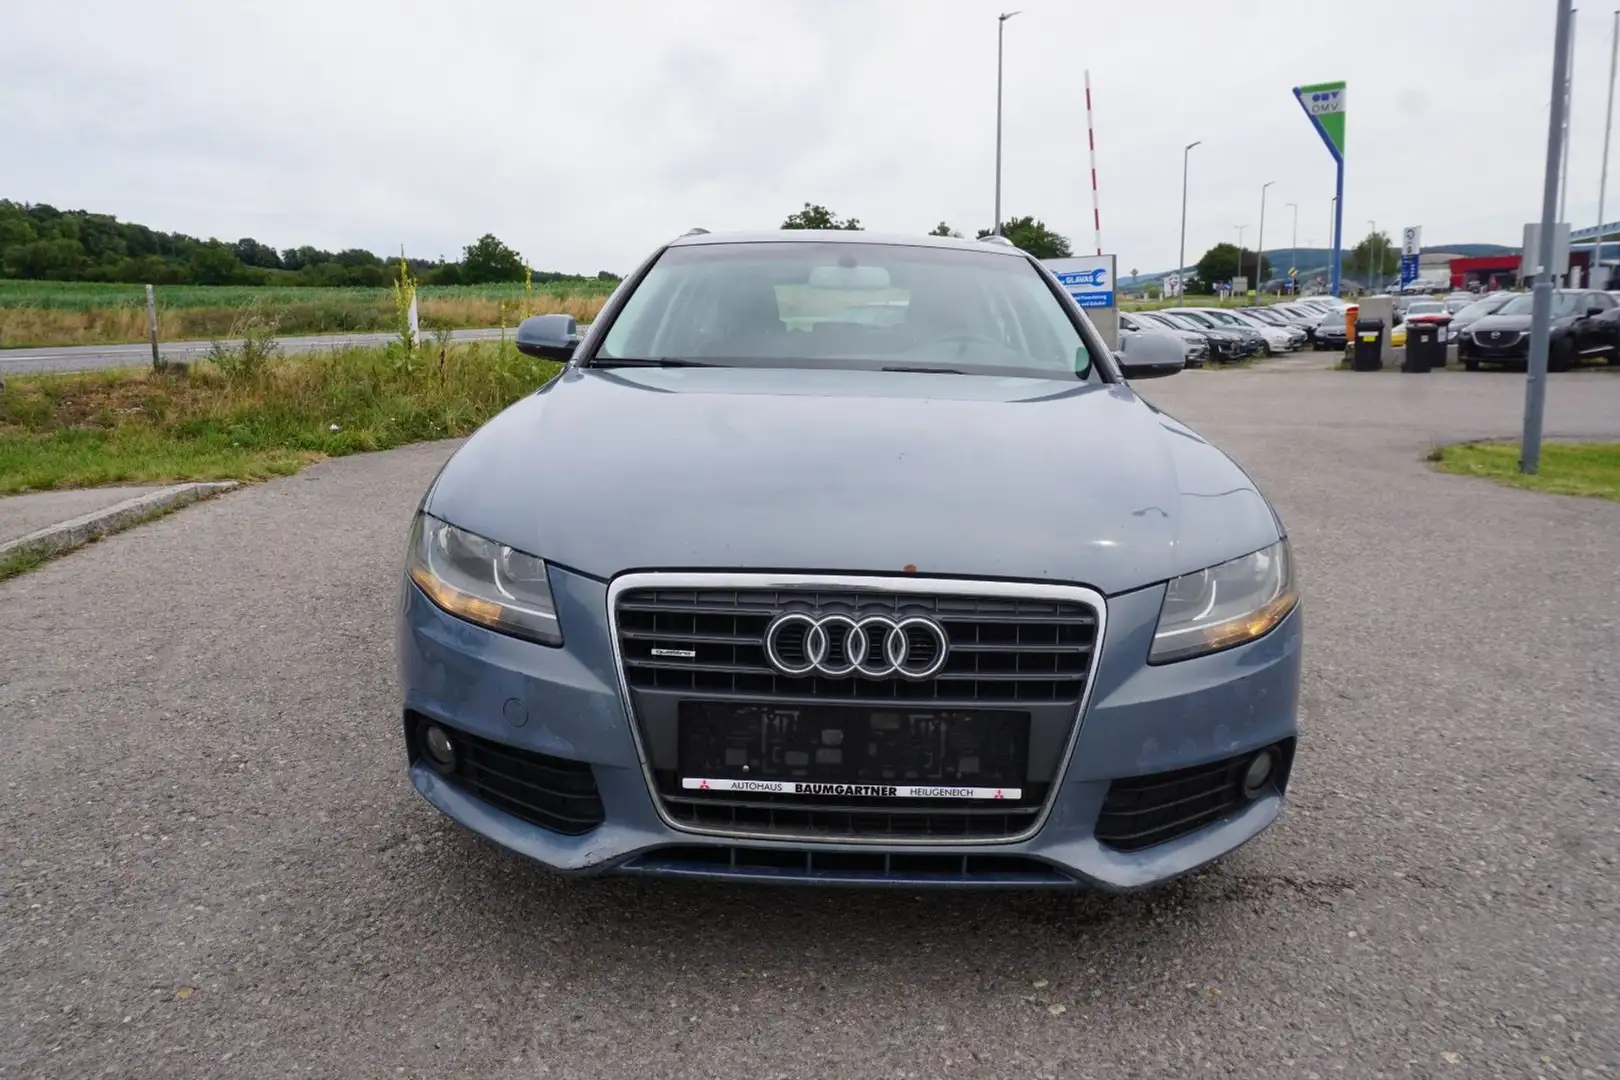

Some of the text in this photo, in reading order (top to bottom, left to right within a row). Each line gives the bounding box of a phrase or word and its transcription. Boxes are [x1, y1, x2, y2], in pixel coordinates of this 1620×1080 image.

[1312, 103, 1339, 113] OMV
[730, 781, 974, 797] AUTOHAUS BAUMGARTNER HEILIGENEICH
